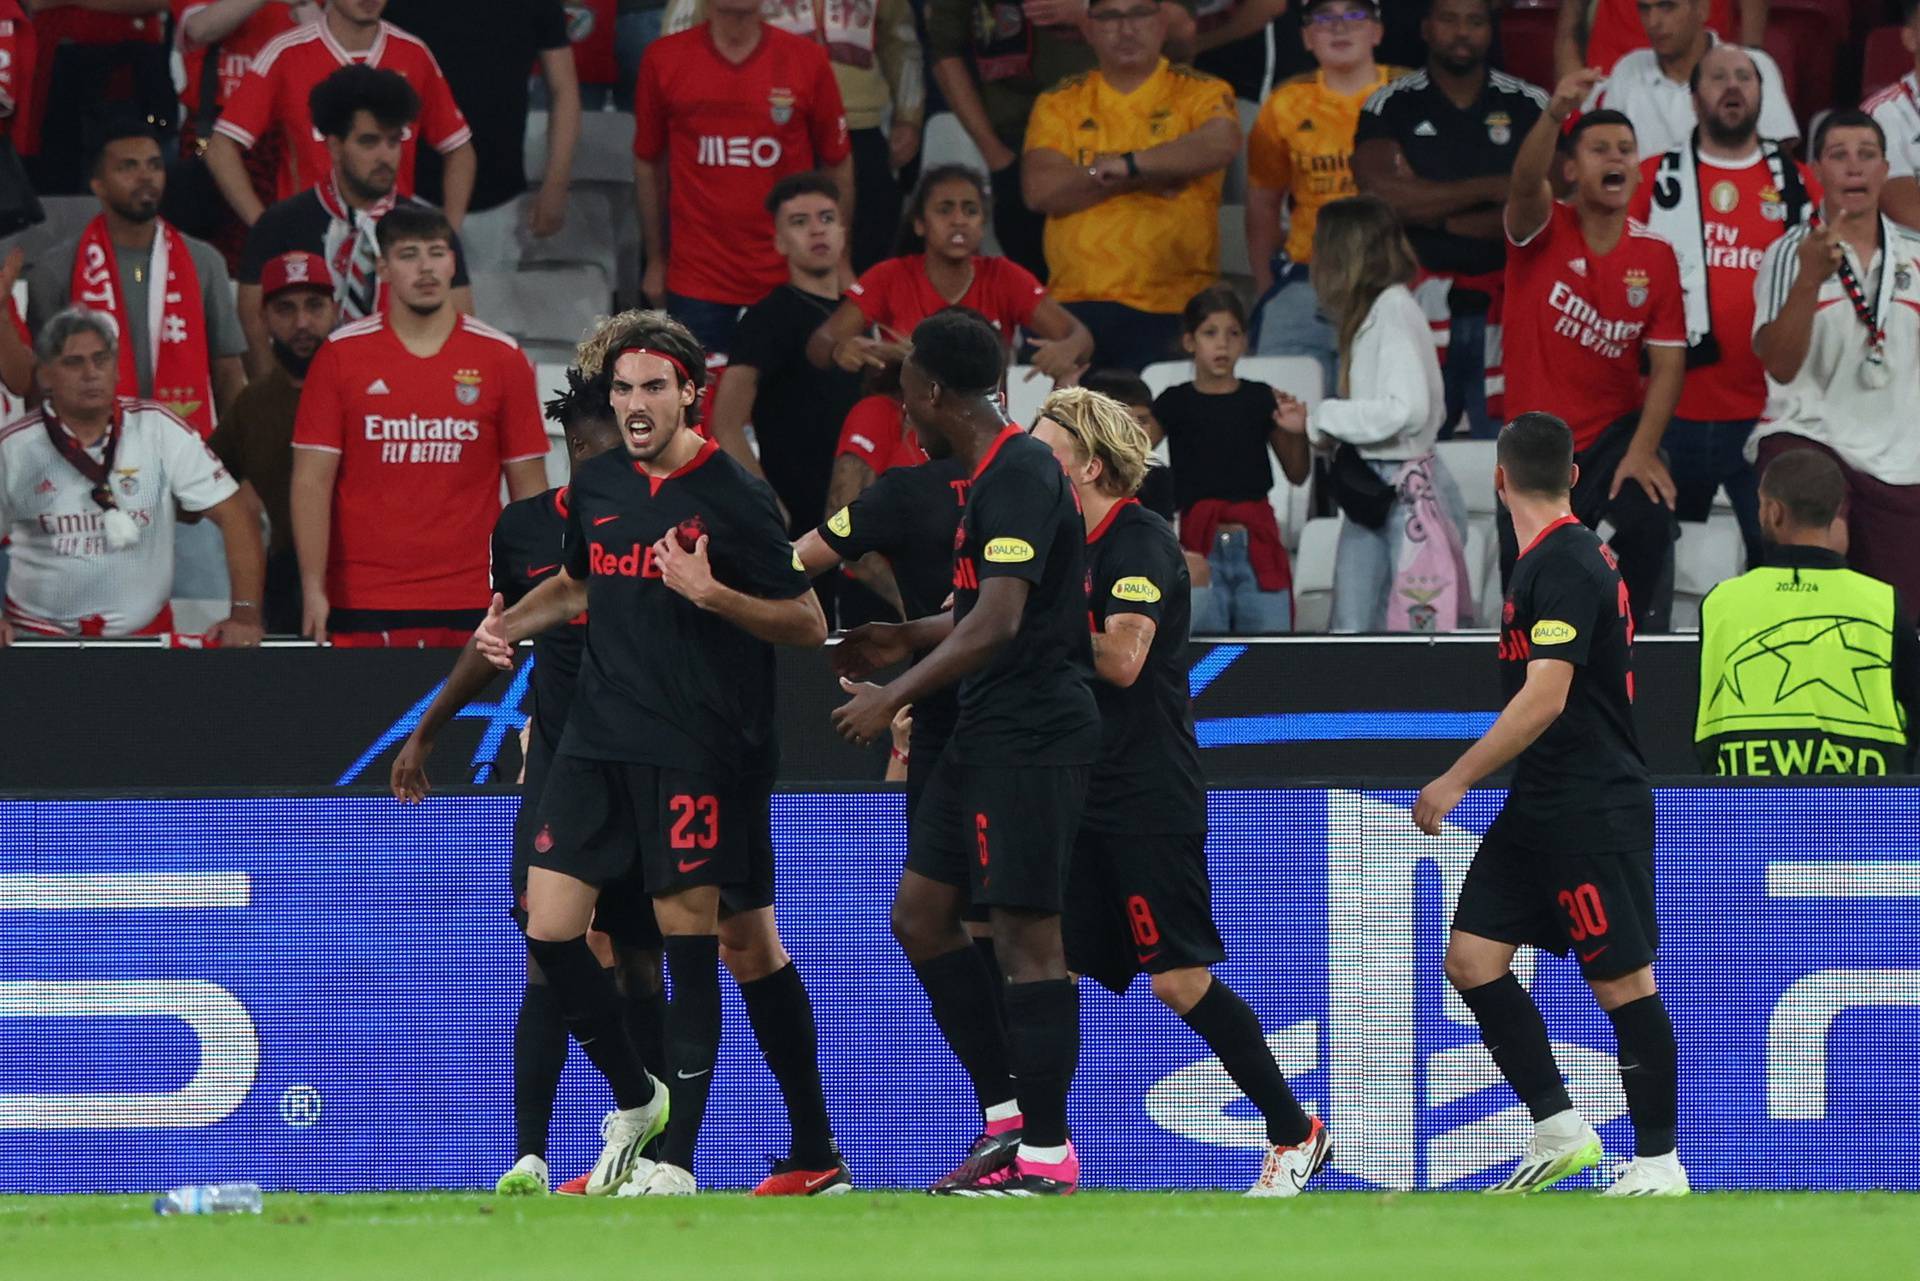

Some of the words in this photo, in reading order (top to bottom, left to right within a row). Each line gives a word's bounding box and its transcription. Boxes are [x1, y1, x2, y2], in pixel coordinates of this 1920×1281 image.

[698, 136, 781, 168] MEO
[1705, 222, 1739, 246] Fly
[364, 412, 479, 441] Emirates
[382, 442, 407, 463] FLY
[410, 442, 462, 463] BETTER
[992, 544, 1029, 557] RAUCH
[1534, 626, 1569, 639] RAUCH
[669, 794, 719, 849] 23
[975, 812, 988, 867] 6
[1557, 883, 1609, 941] 30
